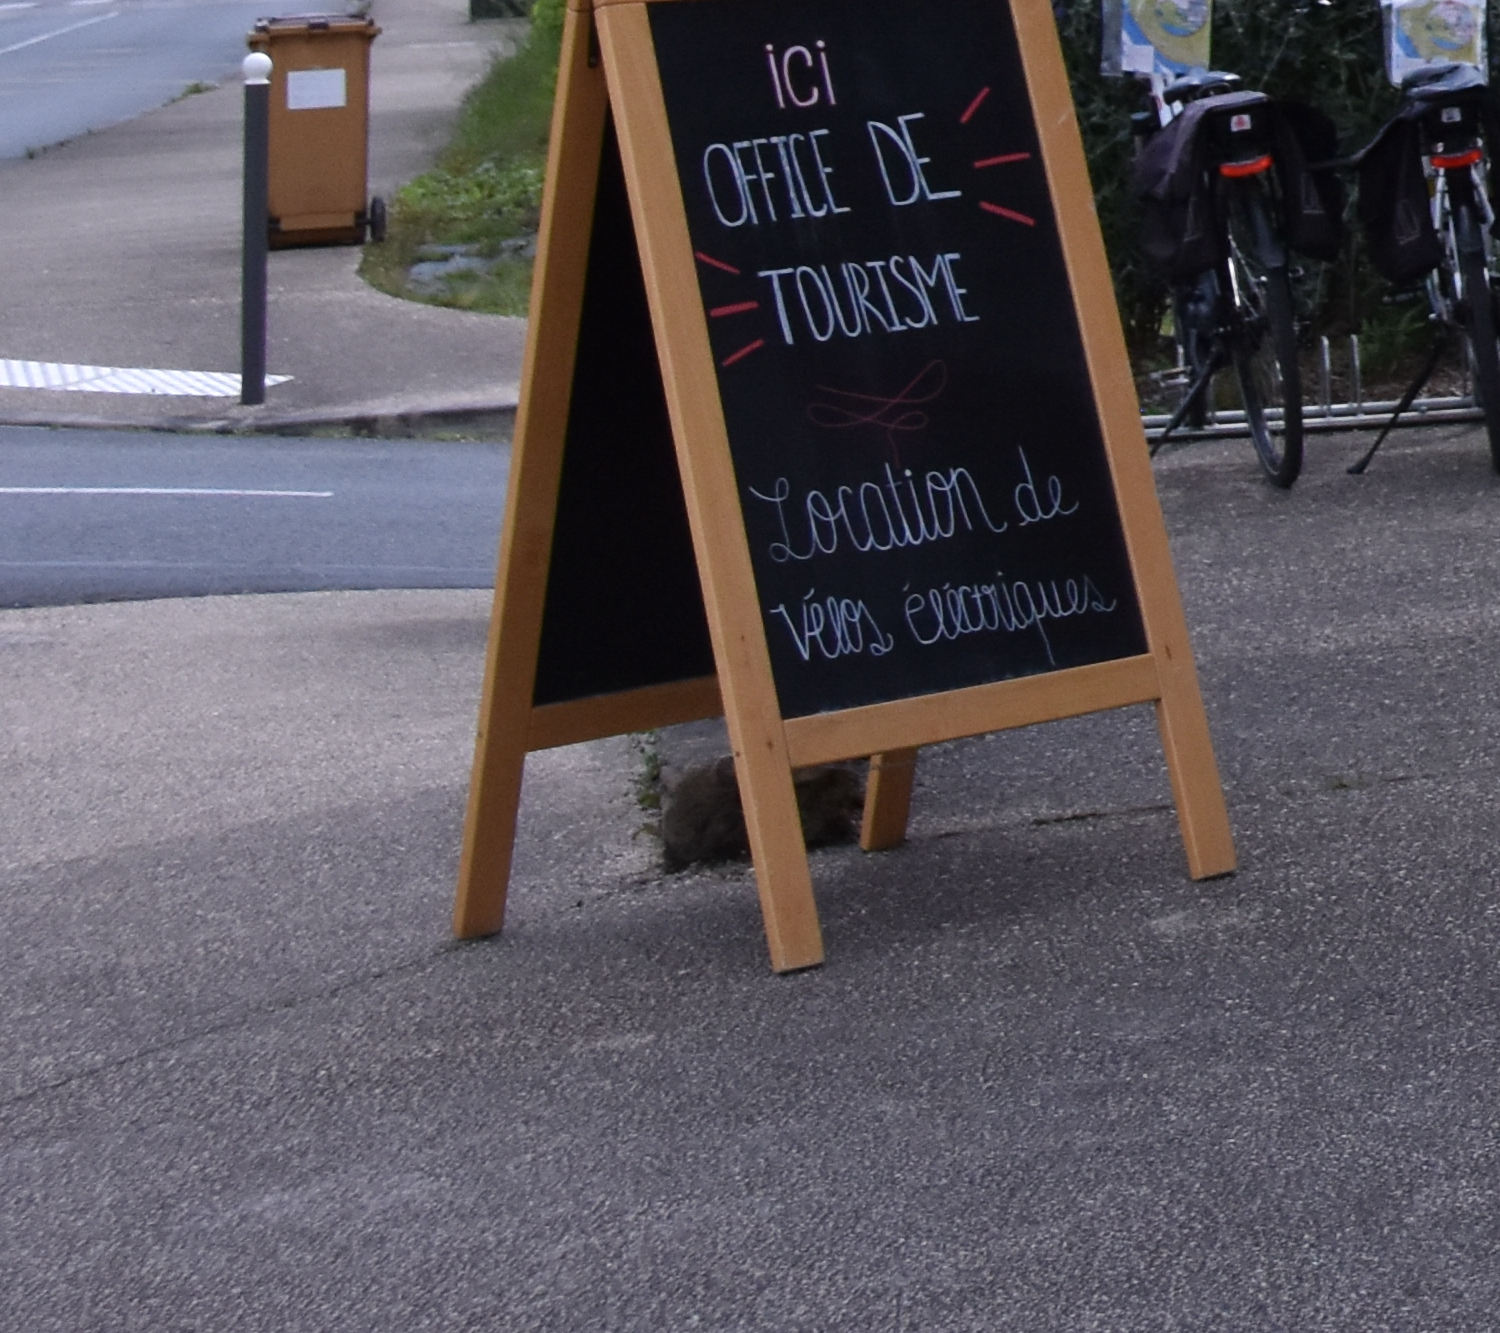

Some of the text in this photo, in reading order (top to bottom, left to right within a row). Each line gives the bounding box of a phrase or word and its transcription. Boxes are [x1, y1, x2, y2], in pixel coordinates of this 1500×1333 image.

[703, 112, 962, 228] OFFICE DE
[757, 252, 980, 346] TOURISME
[750, 445, 1080, 563] Location de
